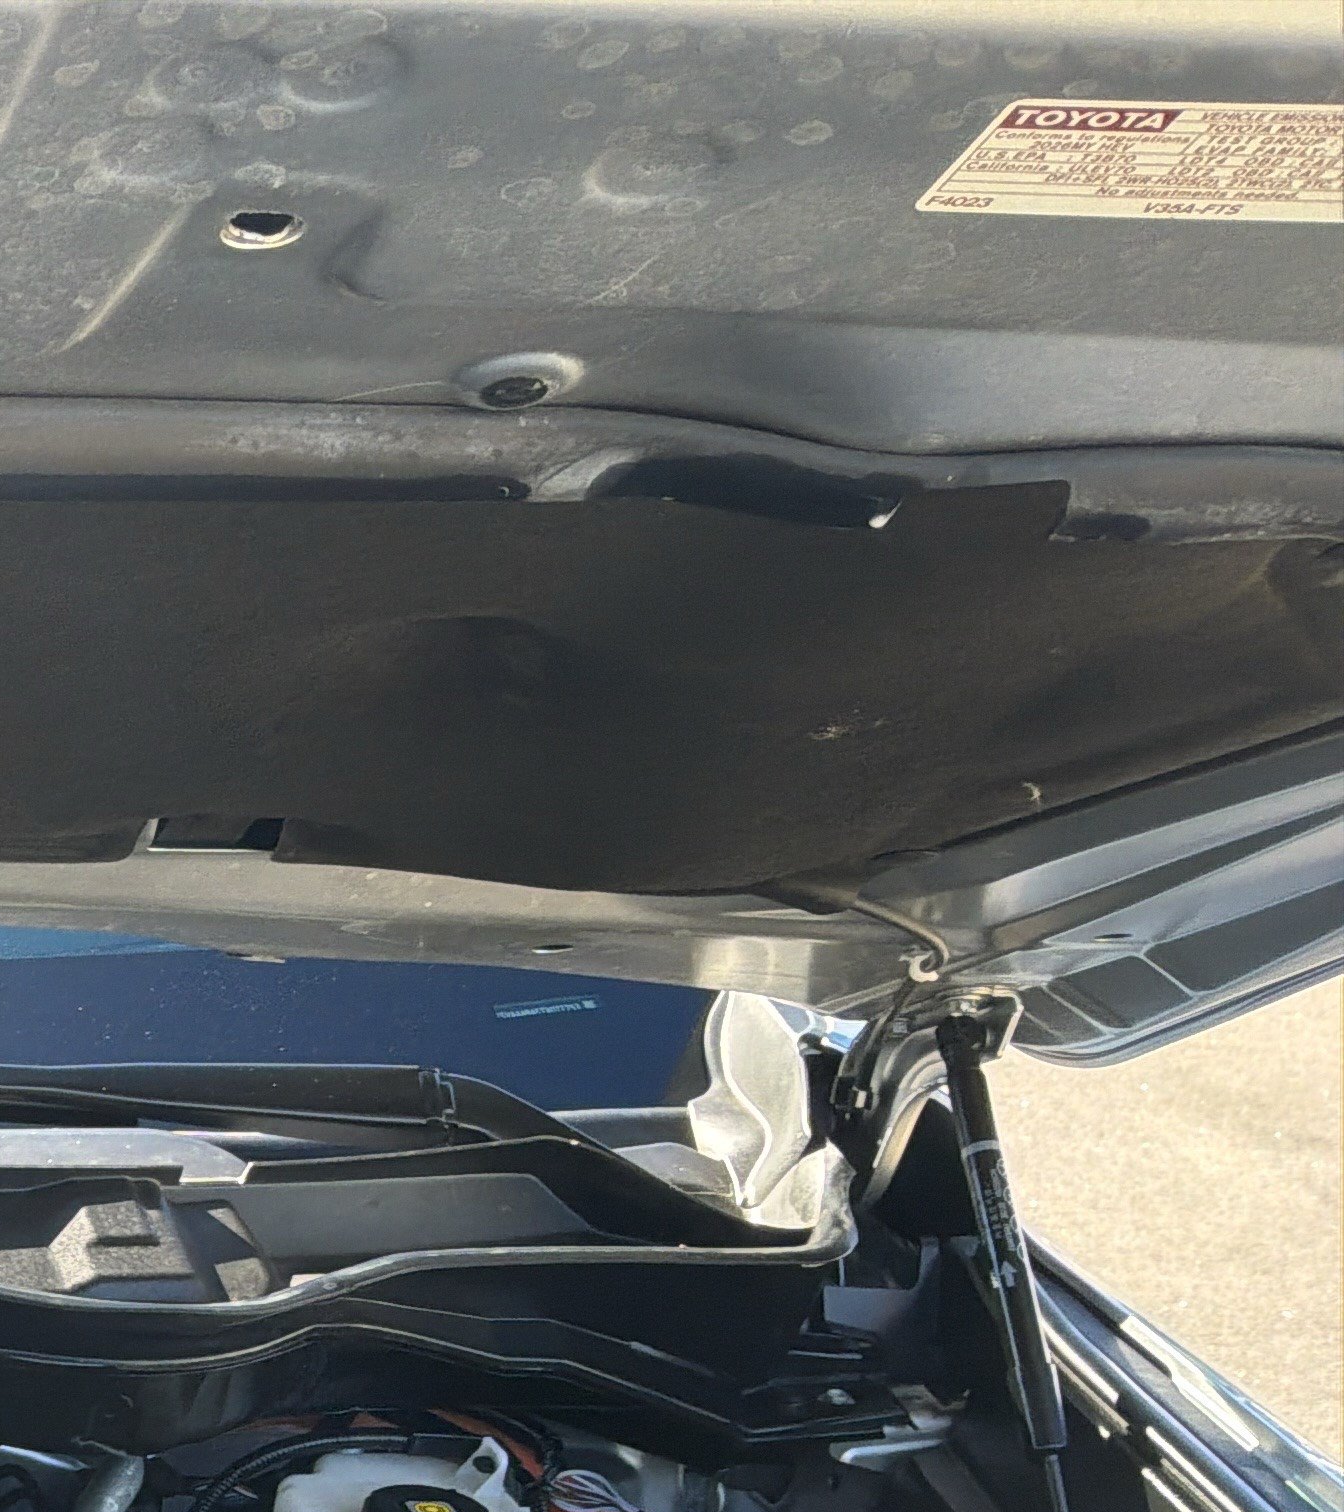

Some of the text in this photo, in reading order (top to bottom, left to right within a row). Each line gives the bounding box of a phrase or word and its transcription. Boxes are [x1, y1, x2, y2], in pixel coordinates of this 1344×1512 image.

[1015, 109, 1165, 130] TOYOTA
[1201, 111, 1268, 122] VEHICLE
[1206, 123, 1343, 135] TOYOTA MOTOR
[995, 131, 1190, 145] Conforms to regulations
[1207, 135, 1255, 145] TEST
[1029, 141, 1136, 152] 2026MY HEV
[1194, 145, 1247, 155] EVAP
[1244, 157, 1285, 167] OBD
[965, 160, 1050, 172] California
[1068, 162, 1138, 174] ULEV70
[1232, 168, 1274, 177] OBD
[1095, 187, 1121, 196] No
[1124, 188, 1229, 200] adjustments
[925, 195, 995, 208] F4023
[1143, 202, 1245, 216] V35A-FTS
